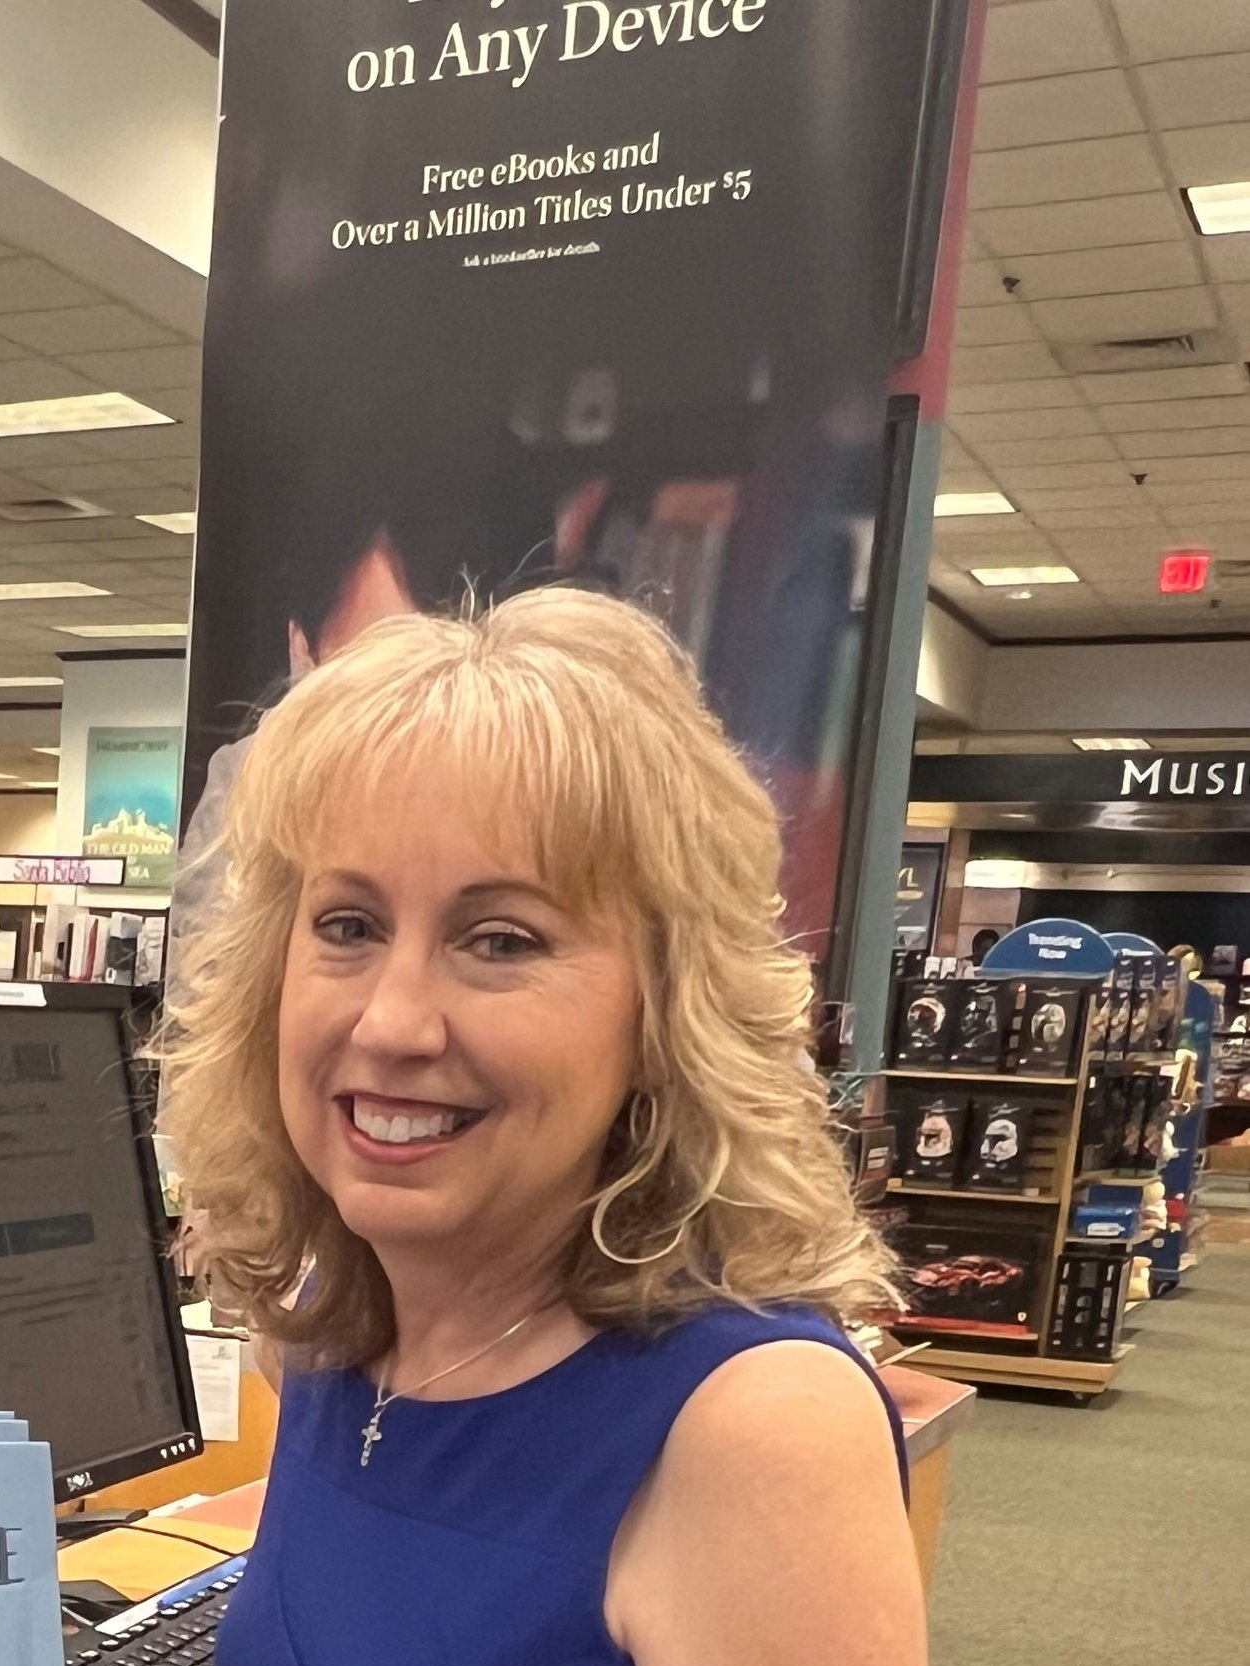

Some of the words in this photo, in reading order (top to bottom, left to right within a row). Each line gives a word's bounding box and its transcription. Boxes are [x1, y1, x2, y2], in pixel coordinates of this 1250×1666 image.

[347, 43, 416, 93] on
[429, 21, 549, 88] Any
[558, 0, 767, 62] Device
[422, 164, 485, 195] Free
[491, 145, 596, 185] eBooks
[603, 131, 661, 169] and
[331, 220, 399, 250] Over
[404, 221, 419, 242] a
[427, 203, 527, 240] Million
[533, 189, 613, 226] Titles
[621, 176, 716, 215] Under
[723, 169, 753, 201] $5
